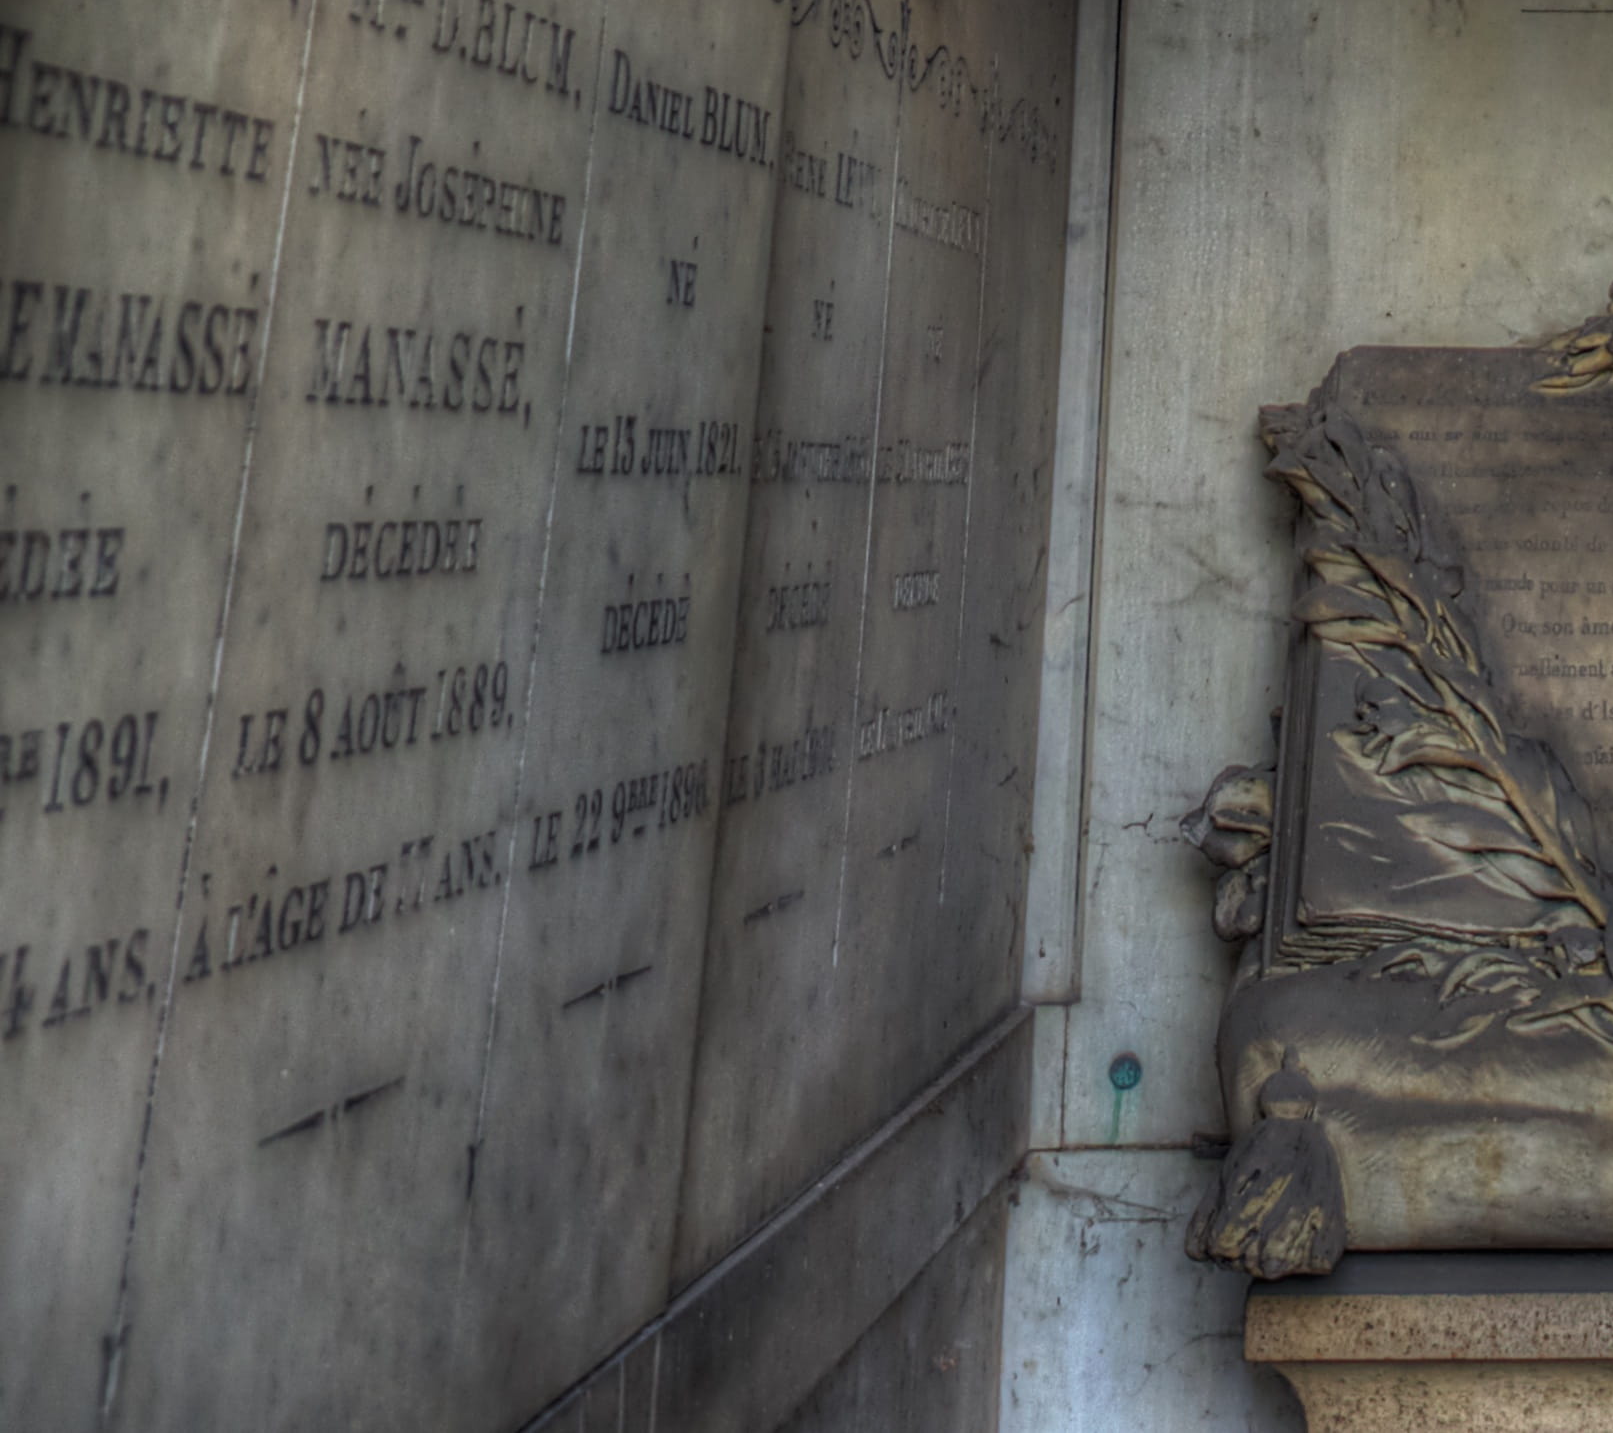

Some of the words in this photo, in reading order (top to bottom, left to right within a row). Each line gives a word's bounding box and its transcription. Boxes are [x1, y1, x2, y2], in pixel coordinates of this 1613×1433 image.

[607, 47, 695, 141] DANIEL
[575, 422, 609, 478] LE
[640, 426, 692, 479] JUIN
[600, 571, 691, 657] DÉCÉDÉ
[231, 707, 289, 783] LE
[300, 685, 325, 768] 8
[527, 809, 563, 873] LE
[336, 861, 390, 941] DE
